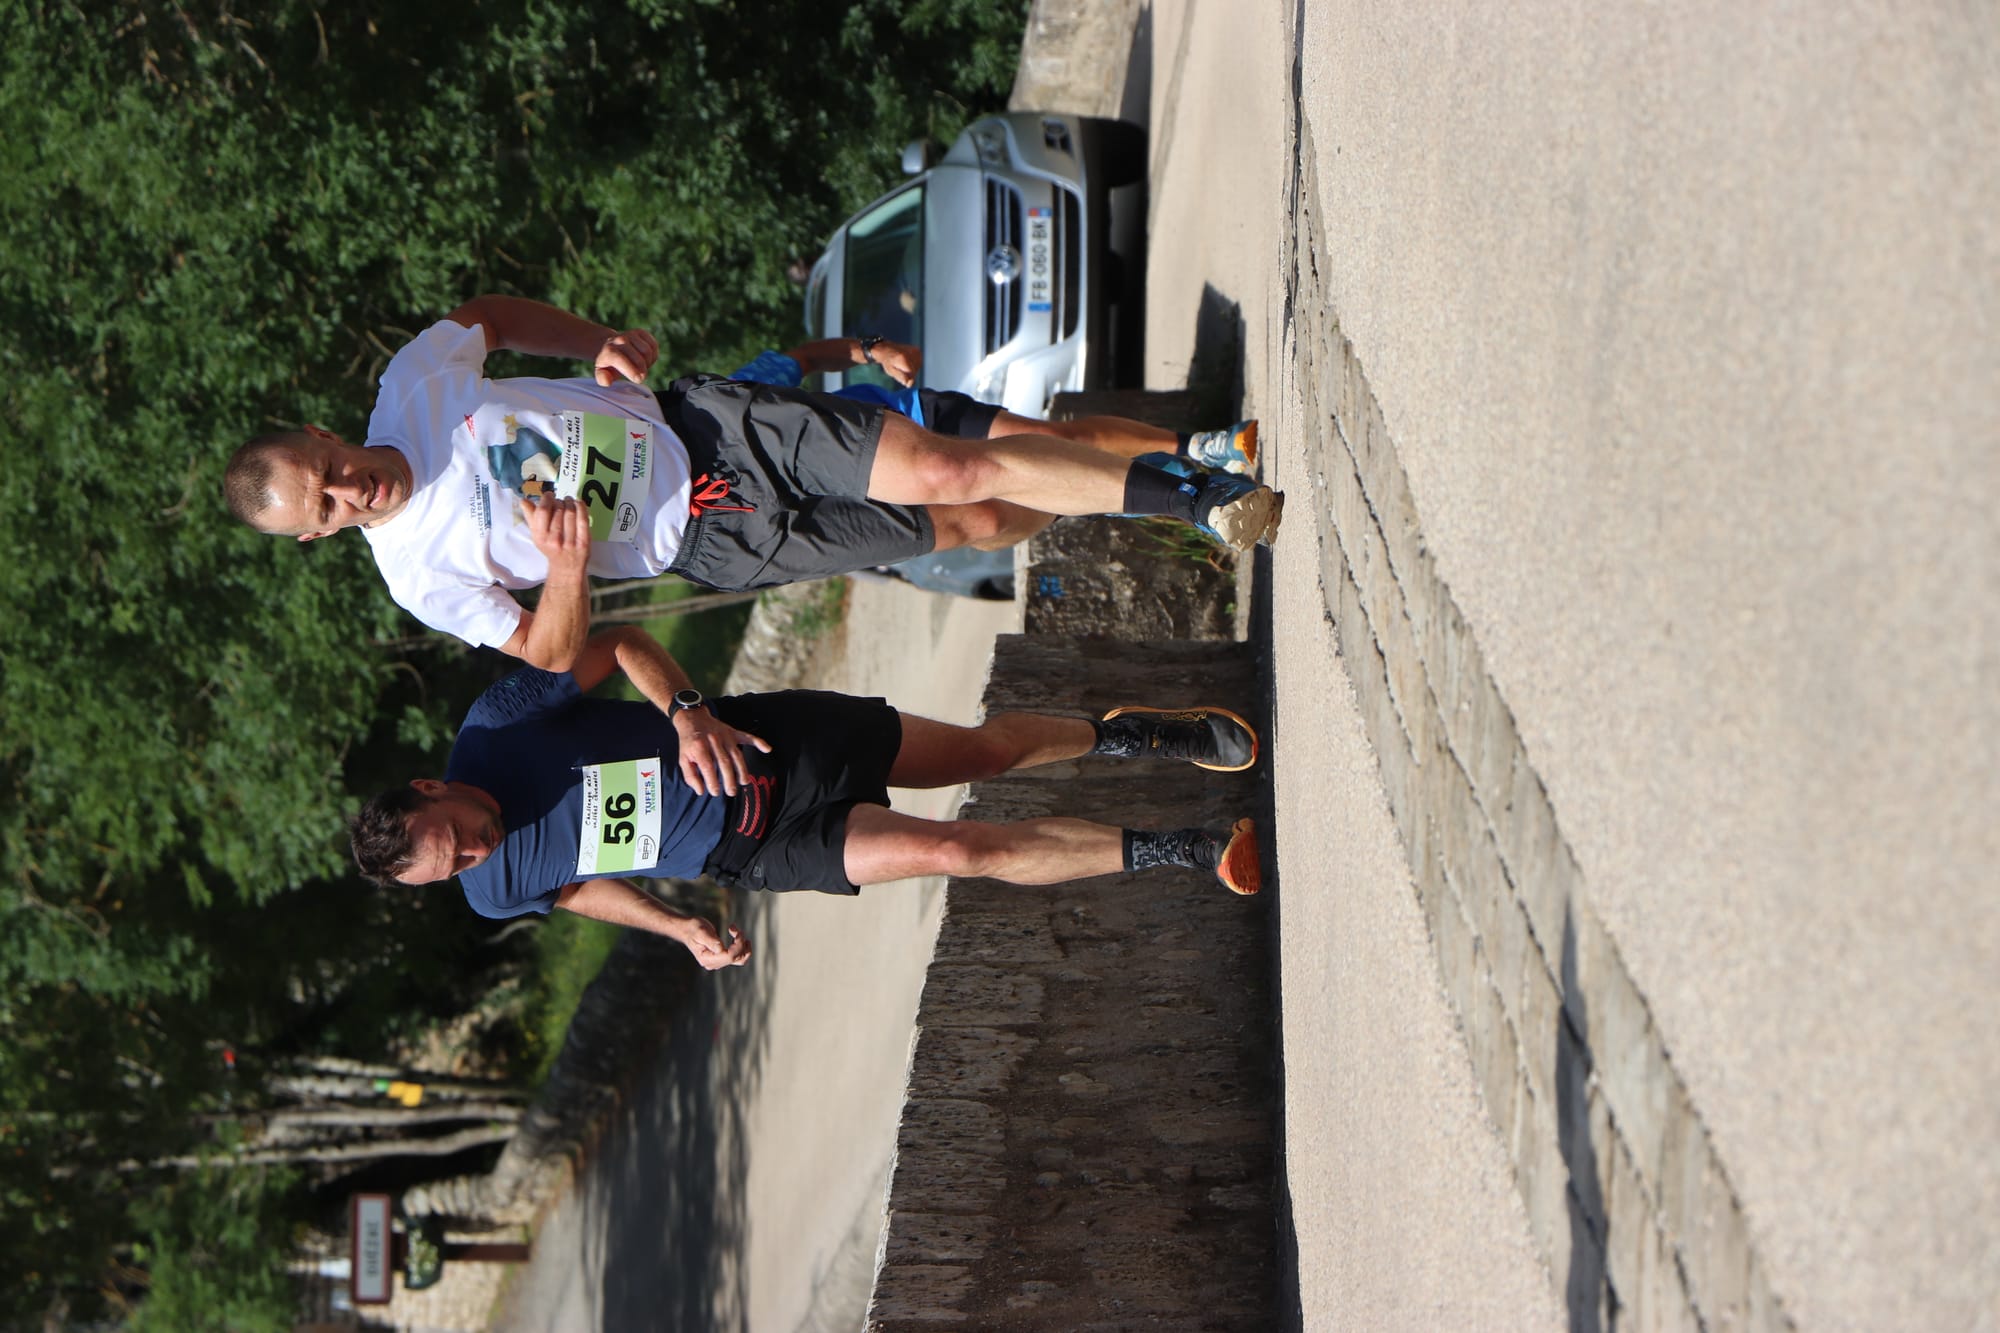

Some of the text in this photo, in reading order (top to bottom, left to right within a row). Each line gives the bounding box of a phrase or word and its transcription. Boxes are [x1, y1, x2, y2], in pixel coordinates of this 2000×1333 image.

[563, 436, 574, 476] Challenge
[632, 442, 641, 480] TUFF'S
[638, 440, 646, 478] Aventure
[581, 446, 622, 510] 27
[585, 791, 594, 826] Challenge
[603, 792, 636, 844] 56
